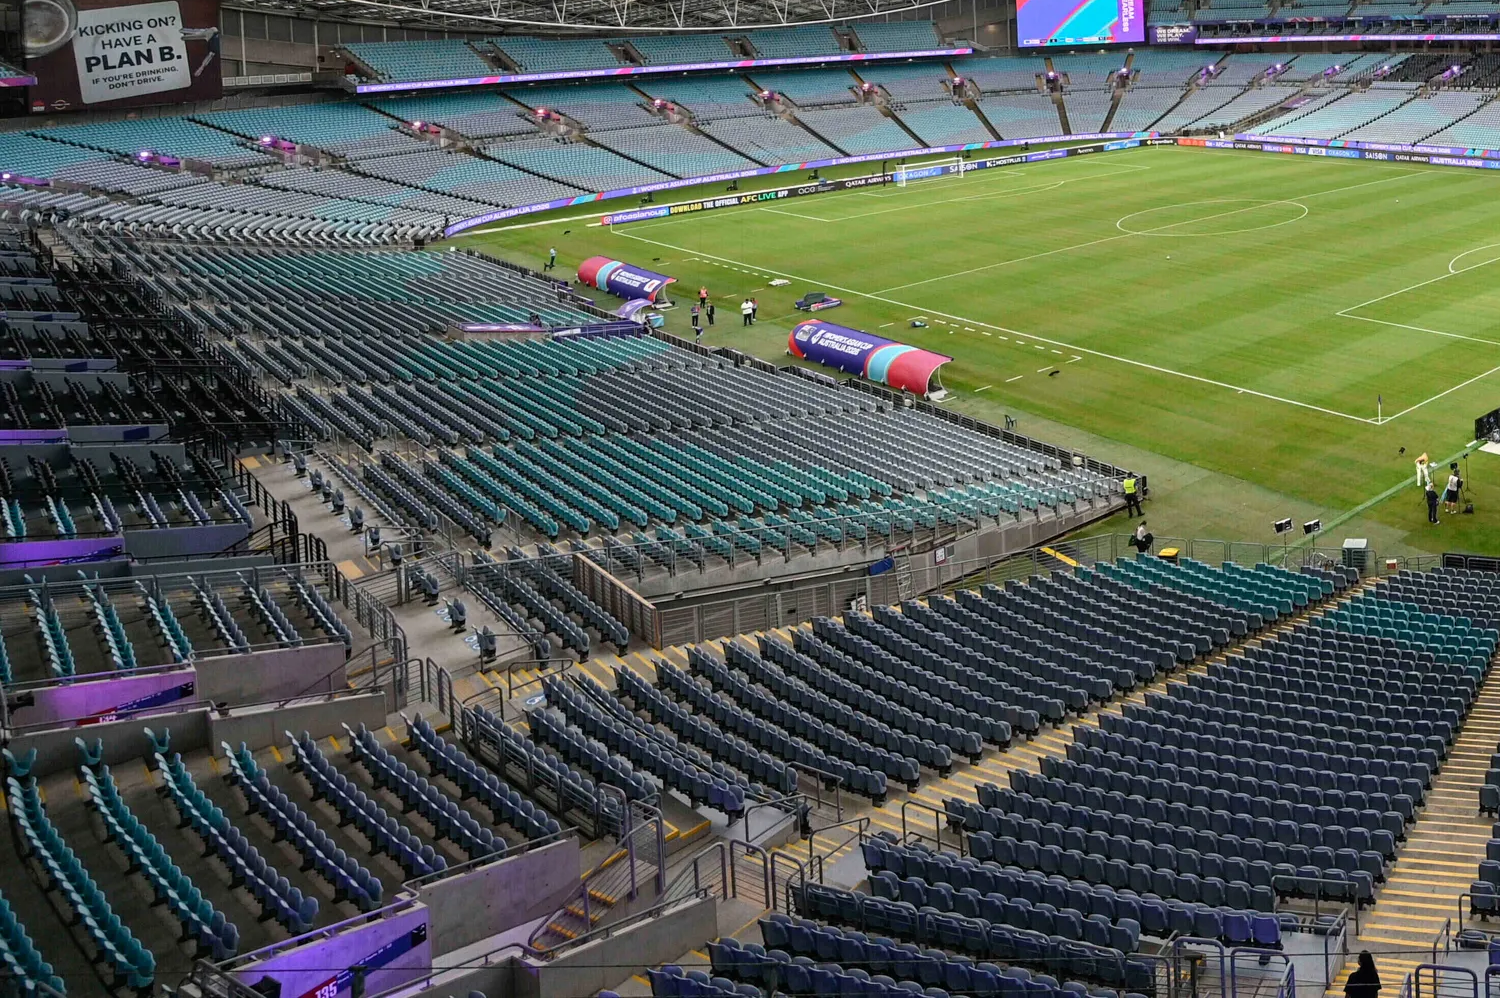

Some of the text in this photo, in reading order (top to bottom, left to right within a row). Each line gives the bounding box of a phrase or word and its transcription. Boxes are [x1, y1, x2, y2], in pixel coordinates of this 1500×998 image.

[79, 16, 176, 37] KICKING ON?
[101, 34, 156, 50] HAVE A
[85, 46, 182, 73] PLAN B.
[102, 72, 134, 84] YOU'RE
[108, 76, 165, 90] DON'T DRIVE.
[1433, 157, 1466, 165] AUSTRALIA
[640, 183, 669, 192] WOMEN'S
[702, 173, 739, 183] AUSTRALIA
[846, 179, 865, 187] QATAR
[670, 202, 702, 213] DOWNLOAD
[715, 198, 739, 208] OFFICIAL
[740, 194, 757, 204] AFC
[758, 192, 776, 201] LIVE
[468, 218, 482, 227] ASIAN
[493, 208, 530, 220] AUSTRALIA
